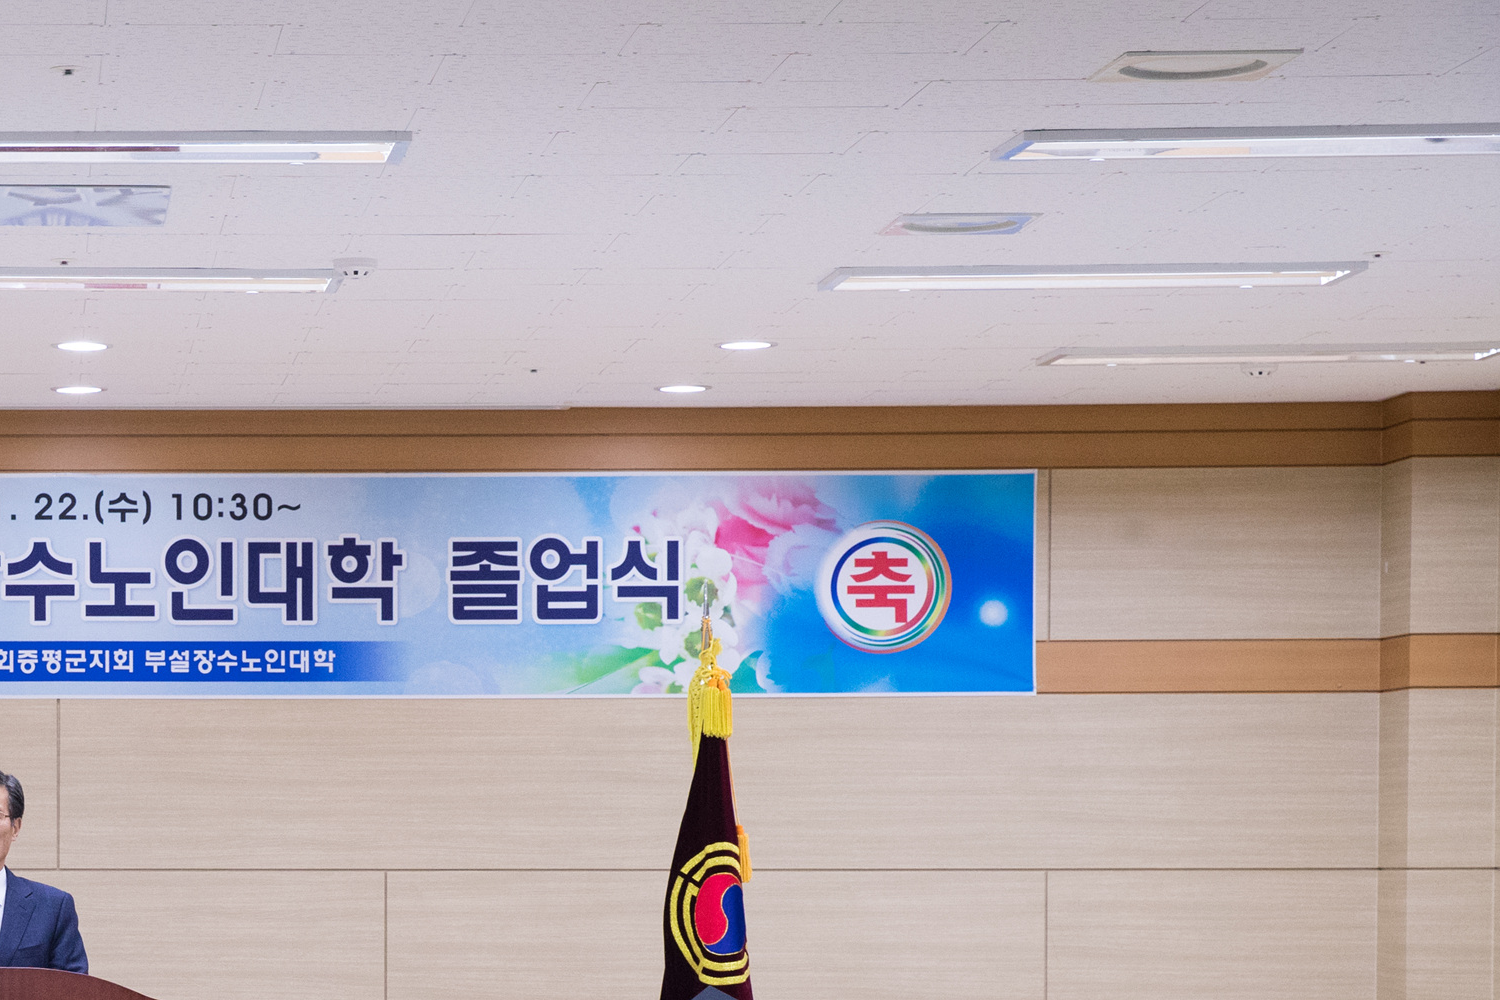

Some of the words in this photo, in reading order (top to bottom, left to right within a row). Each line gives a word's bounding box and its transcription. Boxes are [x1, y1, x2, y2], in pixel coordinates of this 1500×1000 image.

[171, 492, 302, 521] 10:30~
[450, 537, 680, 620] 졸업식
[846, 551, 917, 624] 축
[143, 648, 337, 675] 부설장수노인대학
